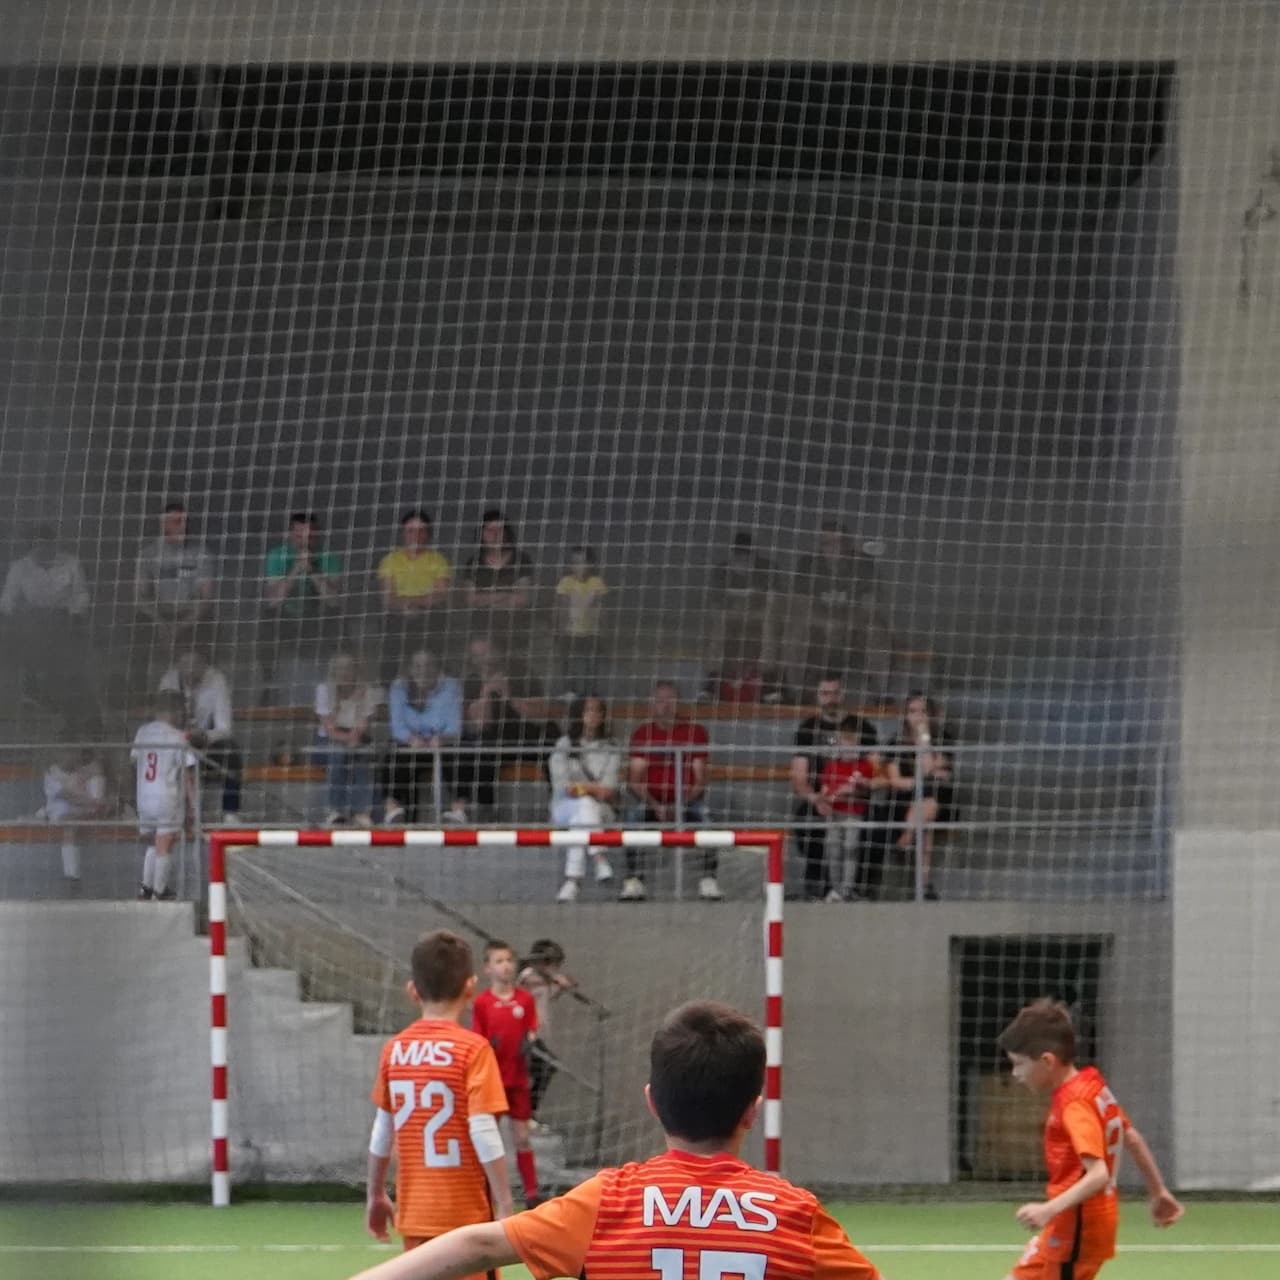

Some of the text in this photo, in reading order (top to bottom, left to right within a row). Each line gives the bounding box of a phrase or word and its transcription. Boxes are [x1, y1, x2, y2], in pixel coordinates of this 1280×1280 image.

[144, 751, 158, 782] 3
[389, 1039, 455, 1067] MAS
[642, 1185, 778, 1233] MAS
